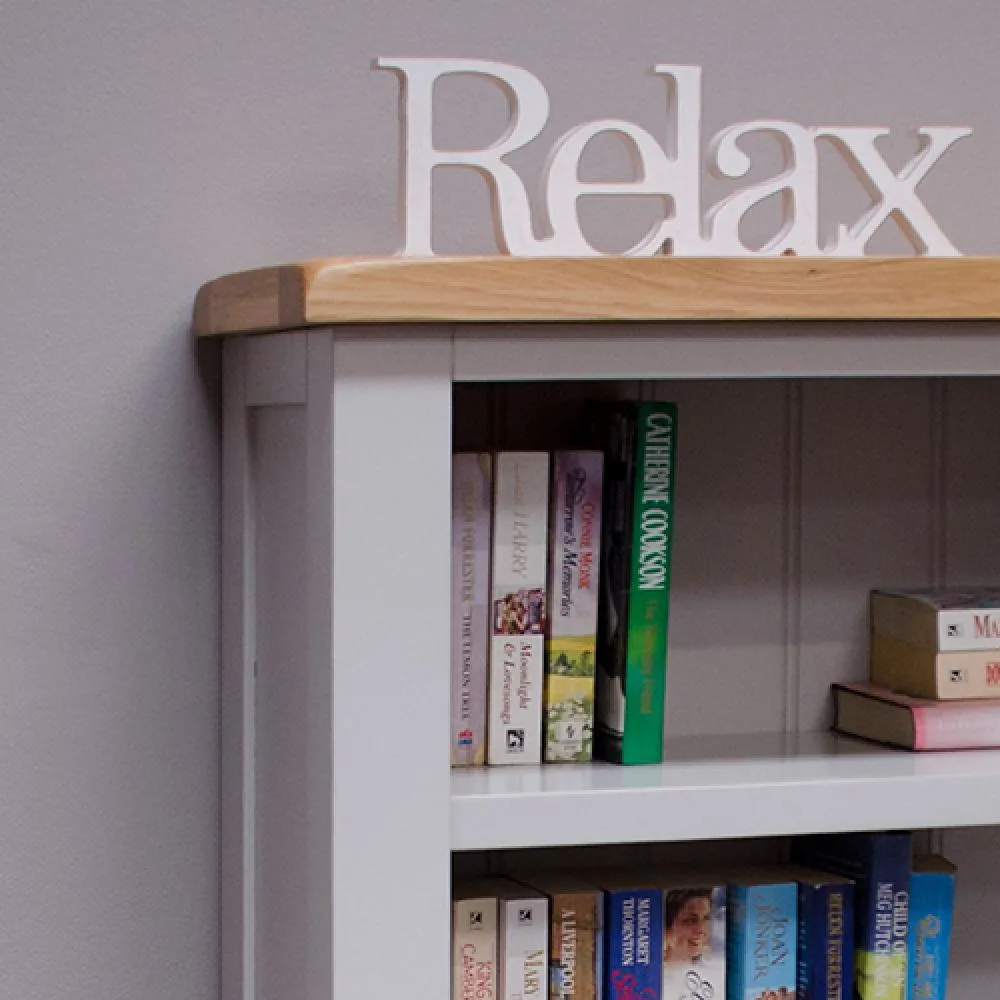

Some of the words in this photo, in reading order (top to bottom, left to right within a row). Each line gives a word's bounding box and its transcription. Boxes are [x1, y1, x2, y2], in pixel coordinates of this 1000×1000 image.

[376, 57, 972, 257] Relax
[641, 412, 673, 504] CATHERINE
[638, 508, 669, 591] COOKSON
[517, 641, 533, 711] Moonlight
[875, 881, 893, 911] MEG
[893, 890, 909, 937] CHILD
[560, 920, 576, 996] LIVERPOOL
[621, 898, 636, 968] THORNTON
[636, 899, 651, 968] MARGARET
[751, 895, 771, 982] JONKER
[769, 906, 791, 967] JOAN
[873, 912, 893, 999] HUTCHINSON
[476, 960, 494, 999] KING
[522, 950, 545, 996] MARY
